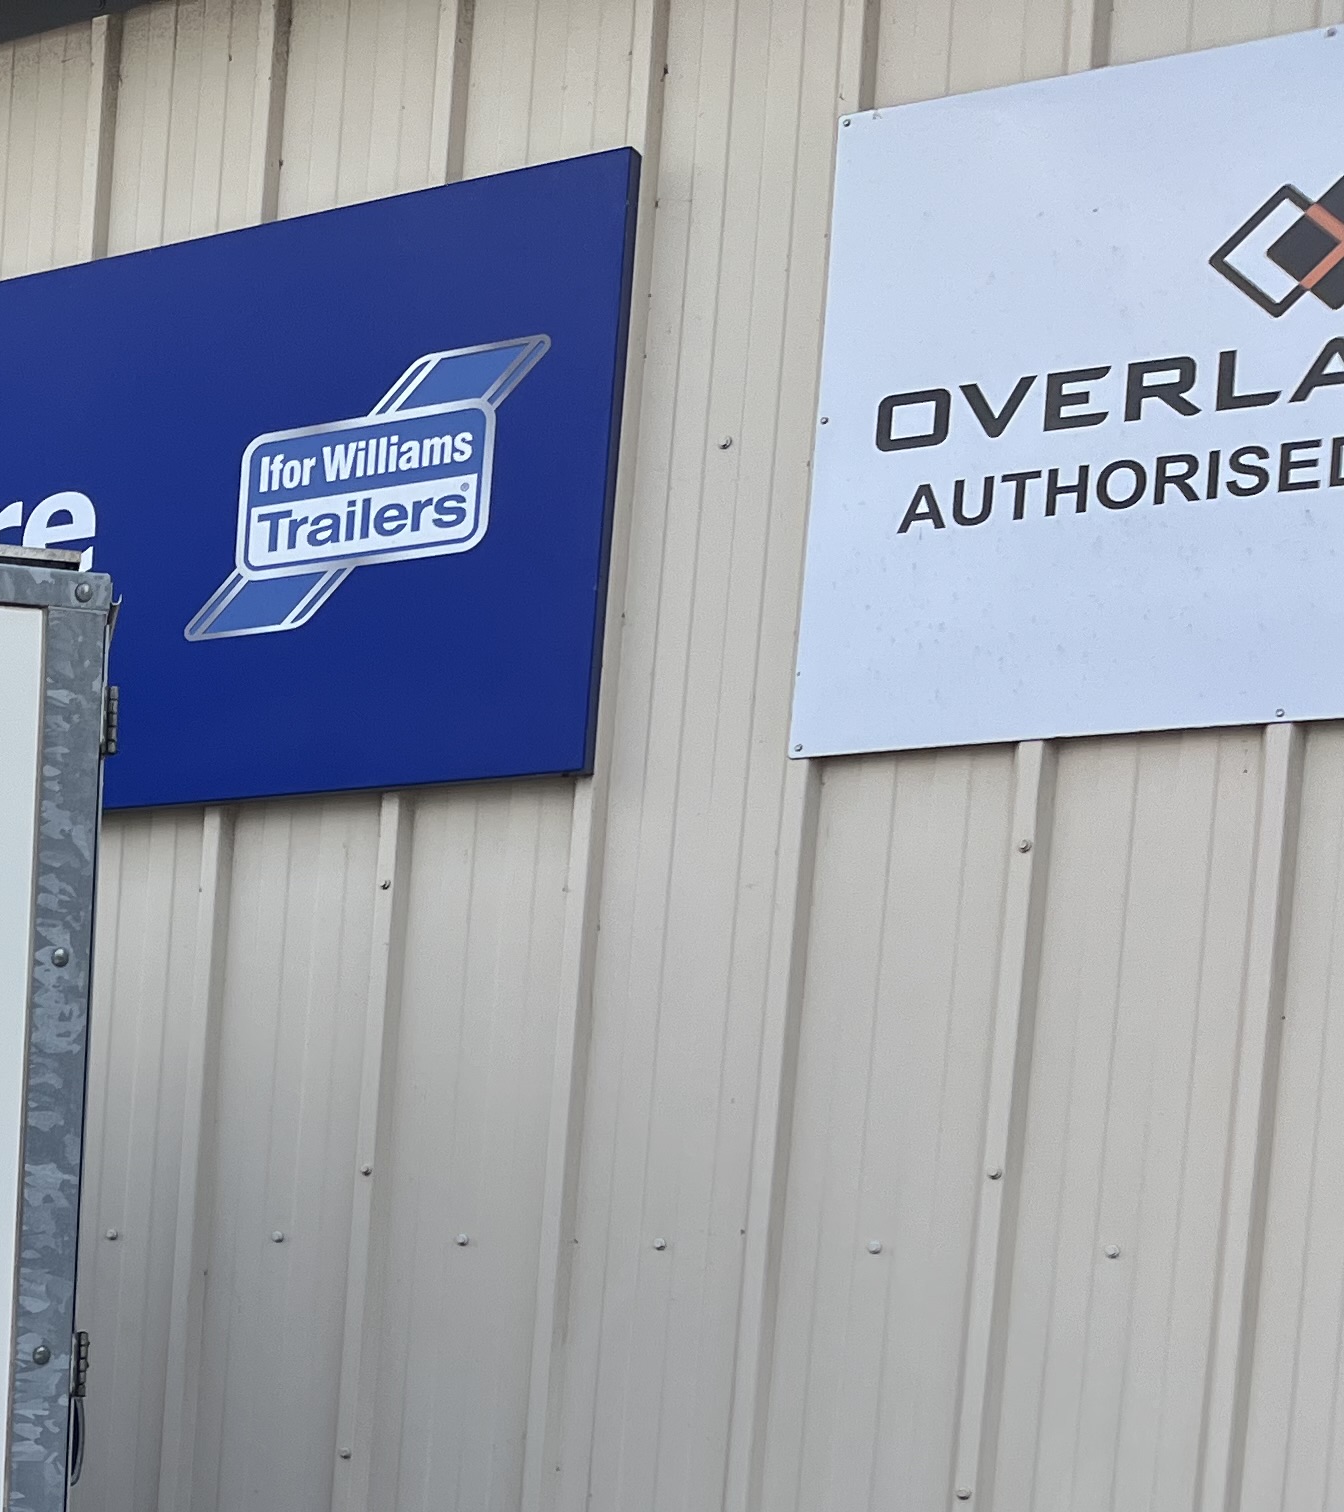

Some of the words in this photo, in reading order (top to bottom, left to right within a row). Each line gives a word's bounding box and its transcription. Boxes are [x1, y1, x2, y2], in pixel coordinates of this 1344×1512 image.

[258, 451, 318, 493] Ifor
[320, 426, 475, 481] Williams
[255, 487, 468, 555] Trailers
